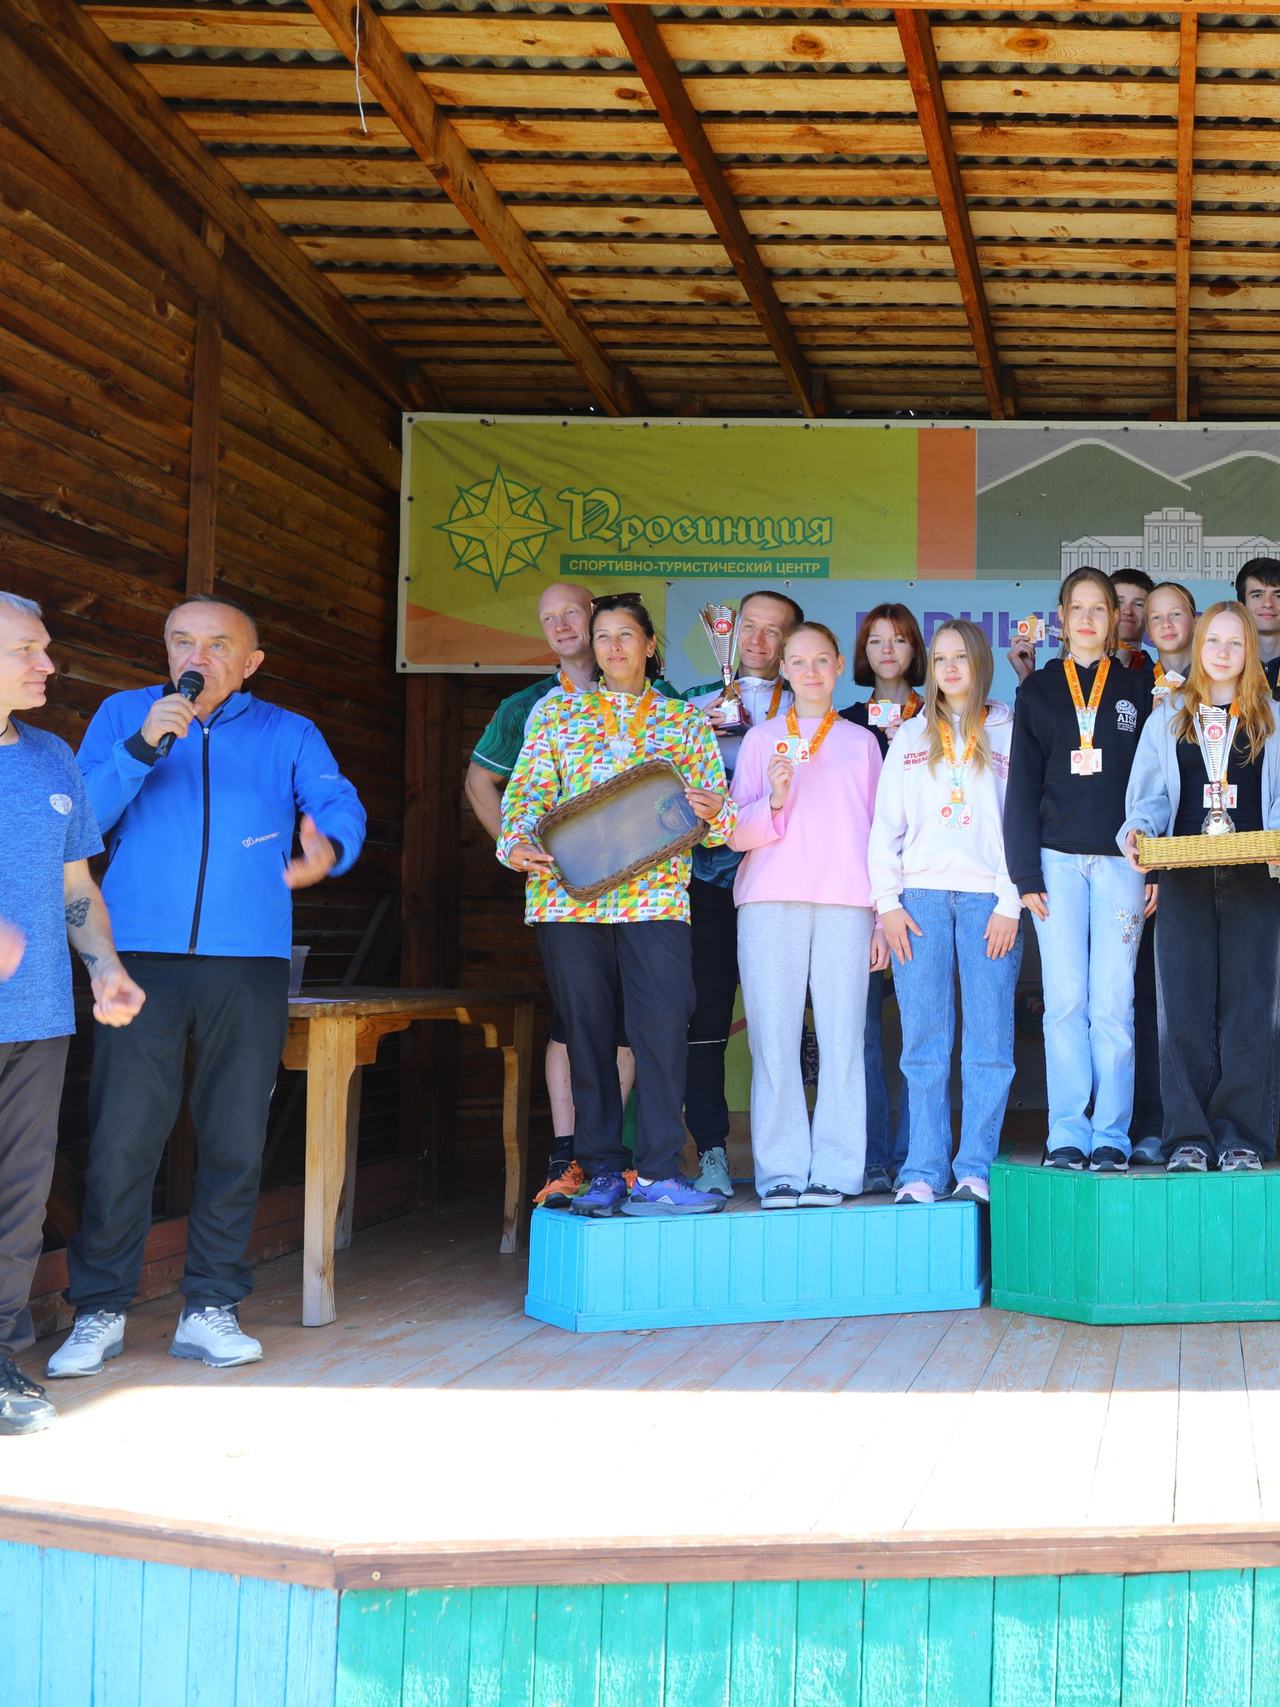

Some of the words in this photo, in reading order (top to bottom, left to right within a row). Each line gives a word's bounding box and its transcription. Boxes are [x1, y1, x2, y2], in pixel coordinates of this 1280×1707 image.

[556, 487, 833, 553] Провинция
[568, 558, 773, 574] СПОРТИВНО-ТУРИСТИЧЕСКИЙ
[776, 561, 821, 576] ЦЕНТР
[962, 816, 970, 825] 2
